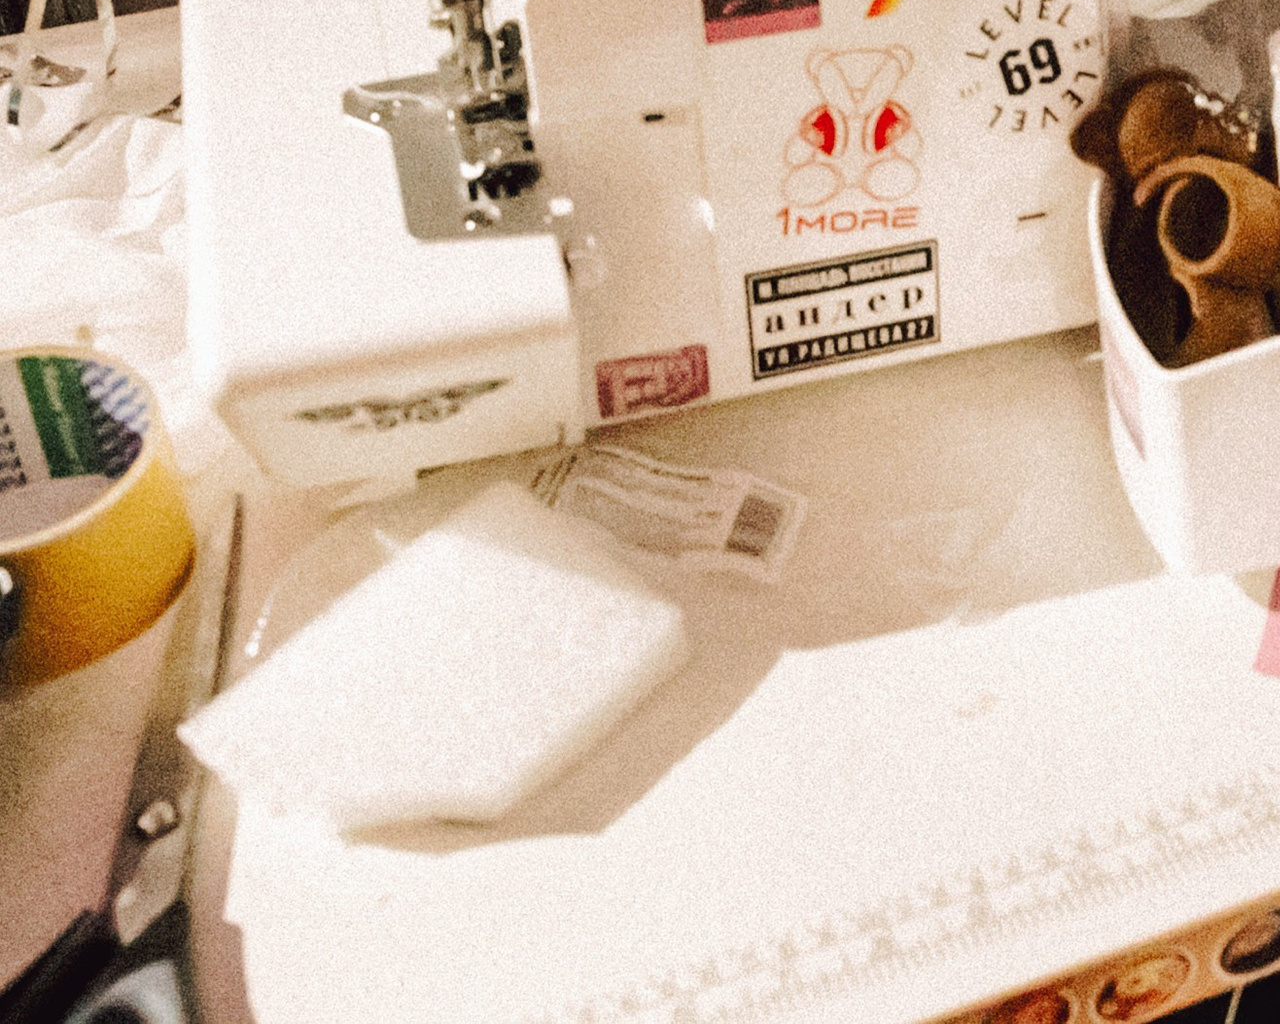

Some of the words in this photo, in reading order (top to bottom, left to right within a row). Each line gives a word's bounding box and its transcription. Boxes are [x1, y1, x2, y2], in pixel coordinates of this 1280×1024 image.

[998, 37, 1062, 96] 69
[989, 70, 1099, 133] LEVEL
[776, 206, 919, 237] 1MORE
